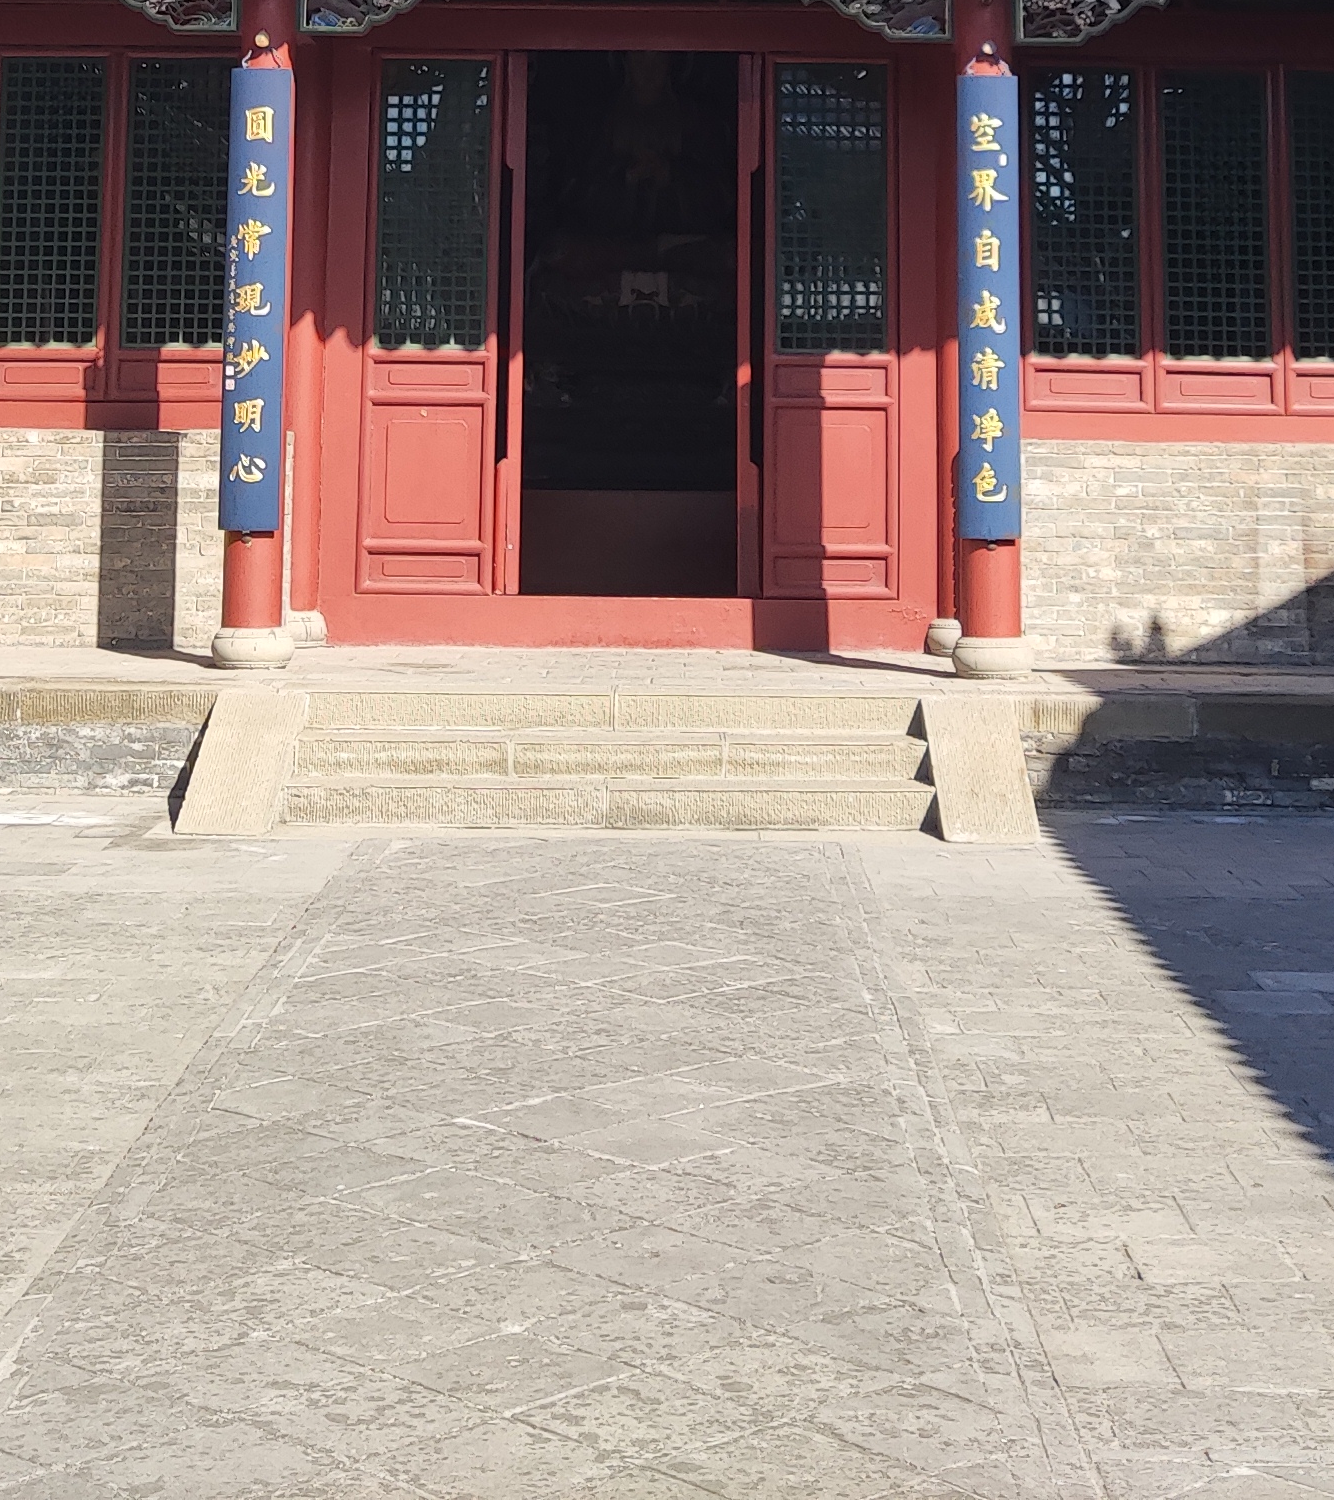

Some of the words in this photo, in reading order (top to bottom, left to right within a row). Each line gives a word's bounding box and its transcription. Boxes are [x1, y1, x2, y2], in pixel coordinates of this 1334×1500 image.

[229, 105, 276, 484] 圓光常現妙明心
